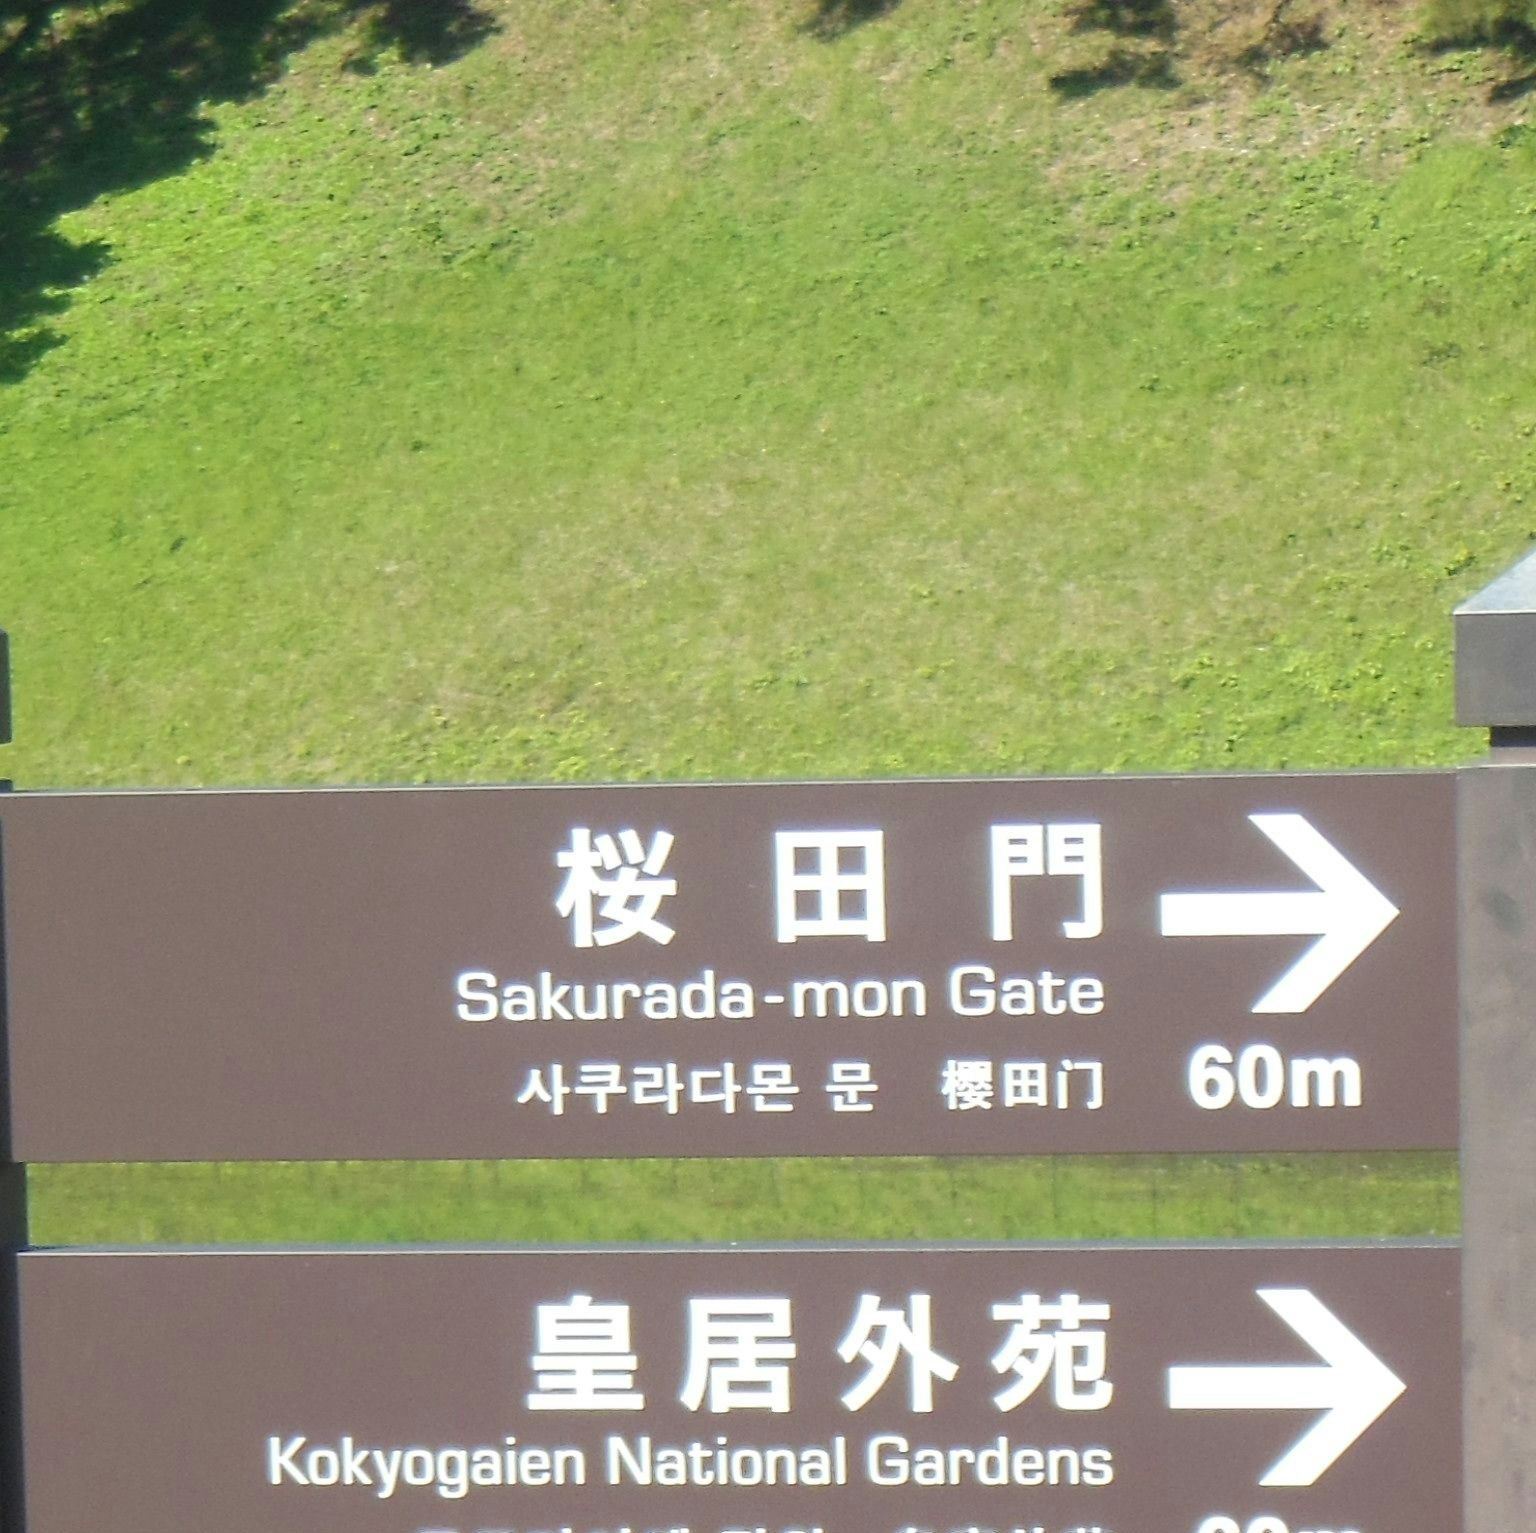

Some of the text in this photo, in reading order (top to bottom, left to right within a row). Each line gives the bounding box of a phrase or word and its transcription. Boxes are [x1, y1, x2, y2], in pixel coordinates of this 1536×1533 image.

[551, 819, 1105, 949] 桜田門
[454, 962, 1106, 1023] Sakurada-mon Gate
[514, 1060, 880, 1116] 사쿠라다몬 문
[1185, 1041, 1363, 1111] 60m
[523, 1288, 1115, 1415] 皇居外苑
[266, 1431, 1115, 1500] Kokyogaien National Gardens
